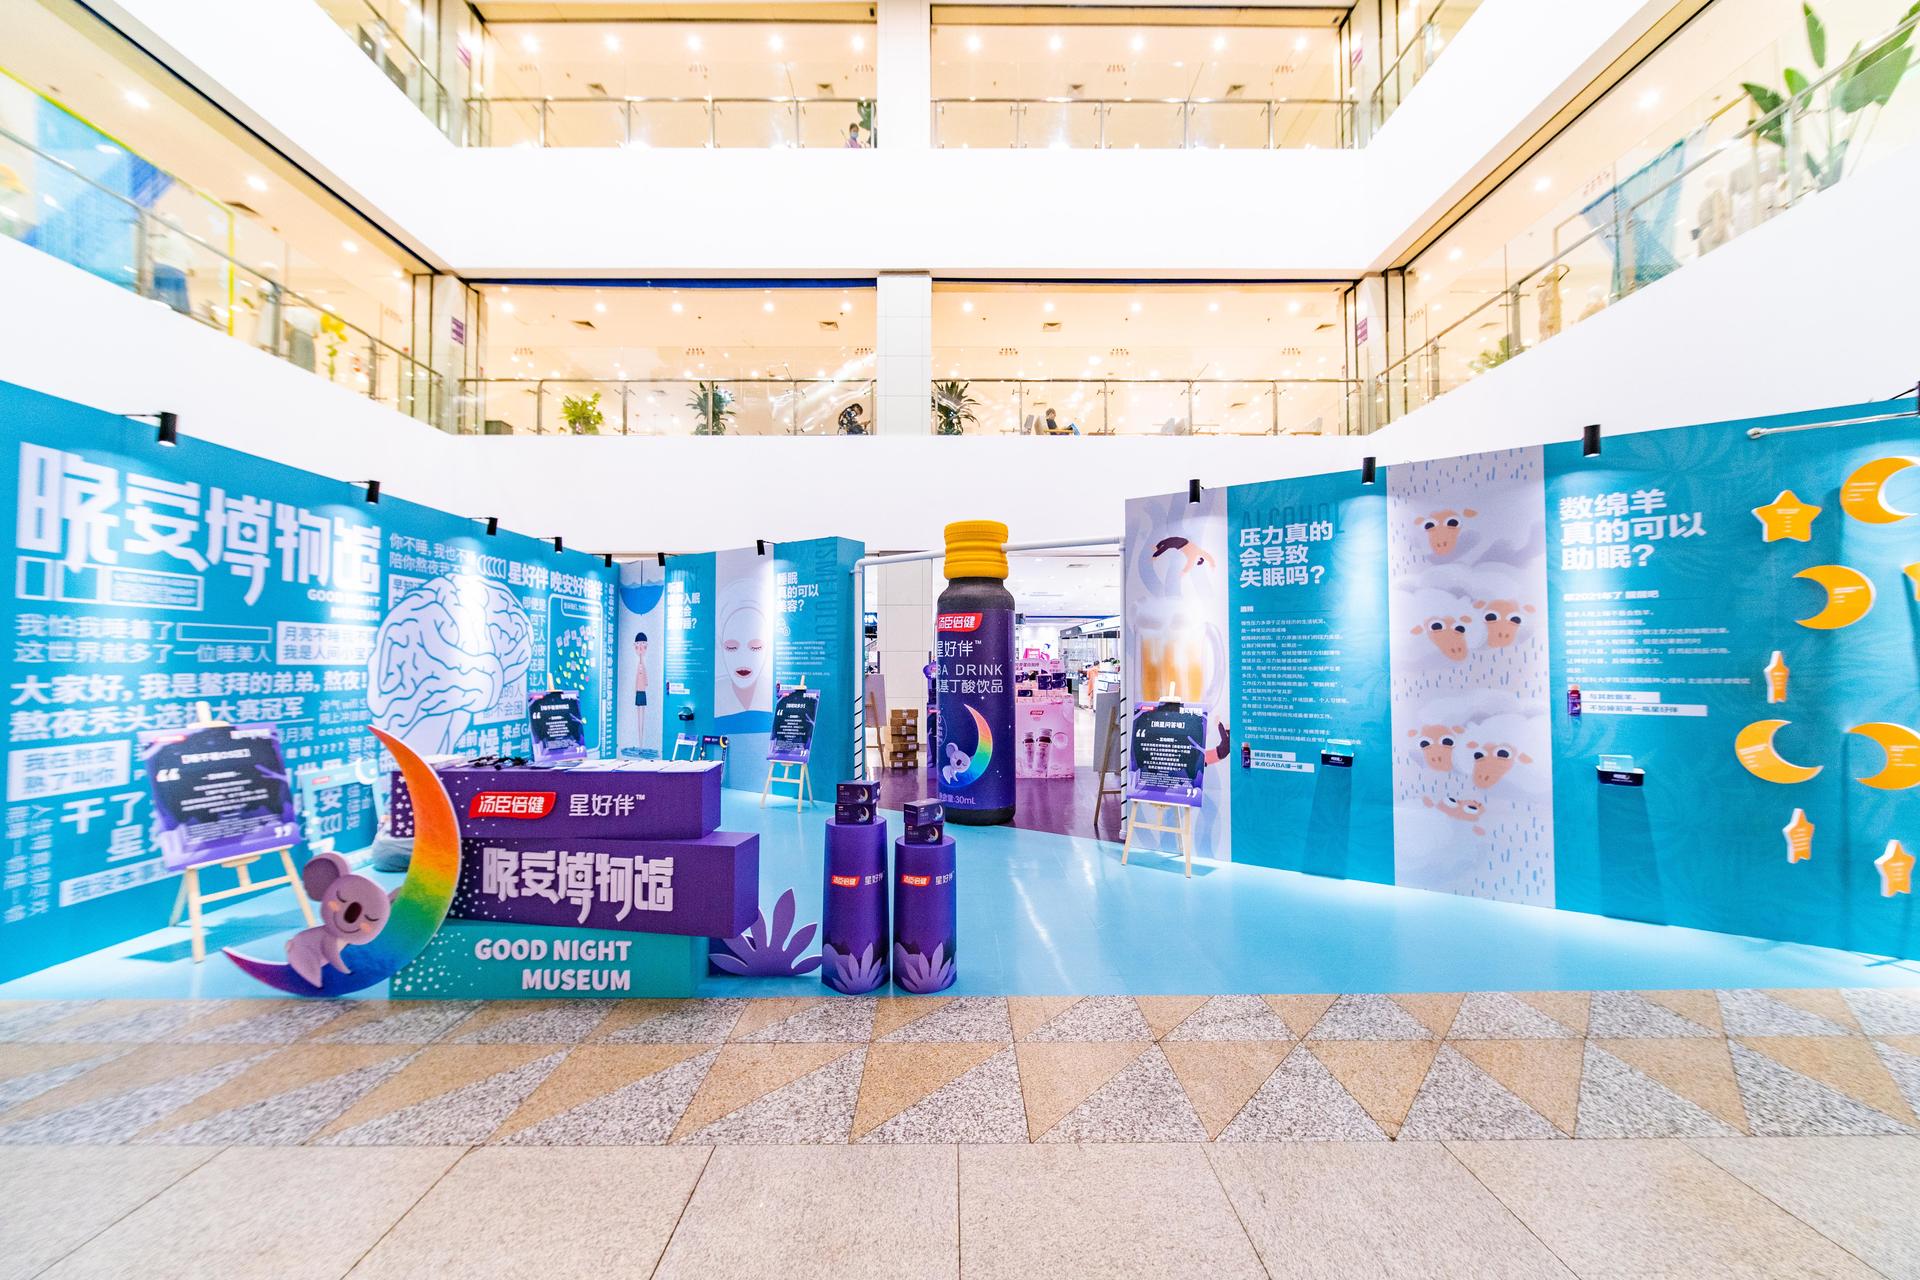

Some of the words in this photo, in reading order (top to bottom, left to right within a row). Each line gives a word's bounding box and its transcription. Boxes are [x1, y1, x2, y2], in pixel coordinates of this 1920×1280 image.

[1560, 489, 1667, 521] 数绵羊
[16, 441, 382, 606] 晚安博物馆
[1239, 520, 1334, 548] 压力真的
[1560, 512, 1707, 545] 真的可以
[1239, 546, 1309, 568] 会导致
[508, 561, 549, 590] 星好伴
[955, 664, 1003, 676] DRINK
[937, 679, 1003, 694] 基丁酸饮品
[478, 795, 545, 815] 汤臣倍健
[482, 847, 675, 924] 晚安博物馆
[474, 938, 548, 961] GOOD
[553, 940, 632, 962] NIGHT
[521, 968, 631, 991] MUSEUM
